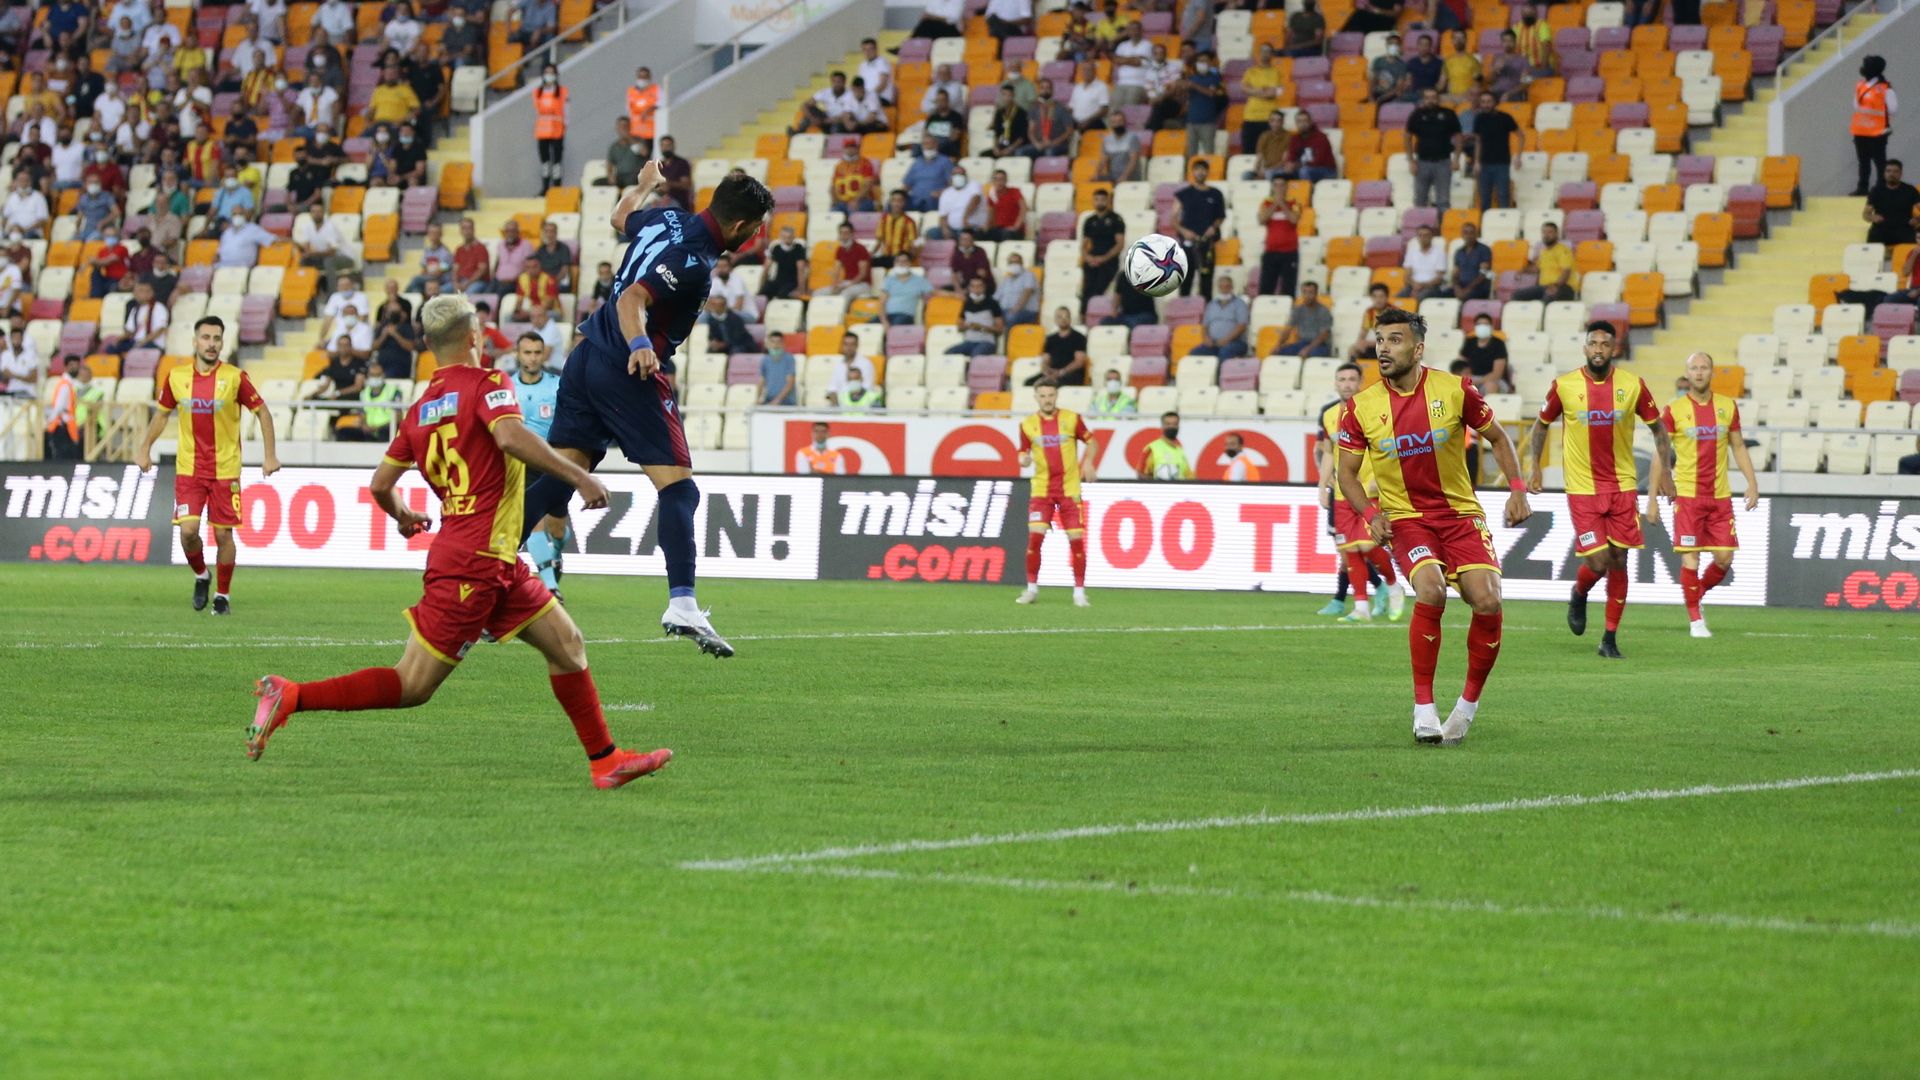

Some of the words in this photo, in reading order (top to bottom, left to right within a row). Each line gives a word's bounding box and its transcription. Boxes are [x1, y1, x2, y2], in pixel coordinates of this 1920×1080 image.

[621, 223, 670, 283] 11
[426, 423, 470, 496] 45
[4, 464, 158, 520] misli
[231, 493, 241, 512] 6
[839, 480, 1013, 538] misli
[28, 525, 151, 563] .com
[1238, 502, 1337, 575] TL
[1409, 546, 1429, 560] HDI
[1481, 530, 1493, 550] 5
[867, 543, 1006, 583] .com
